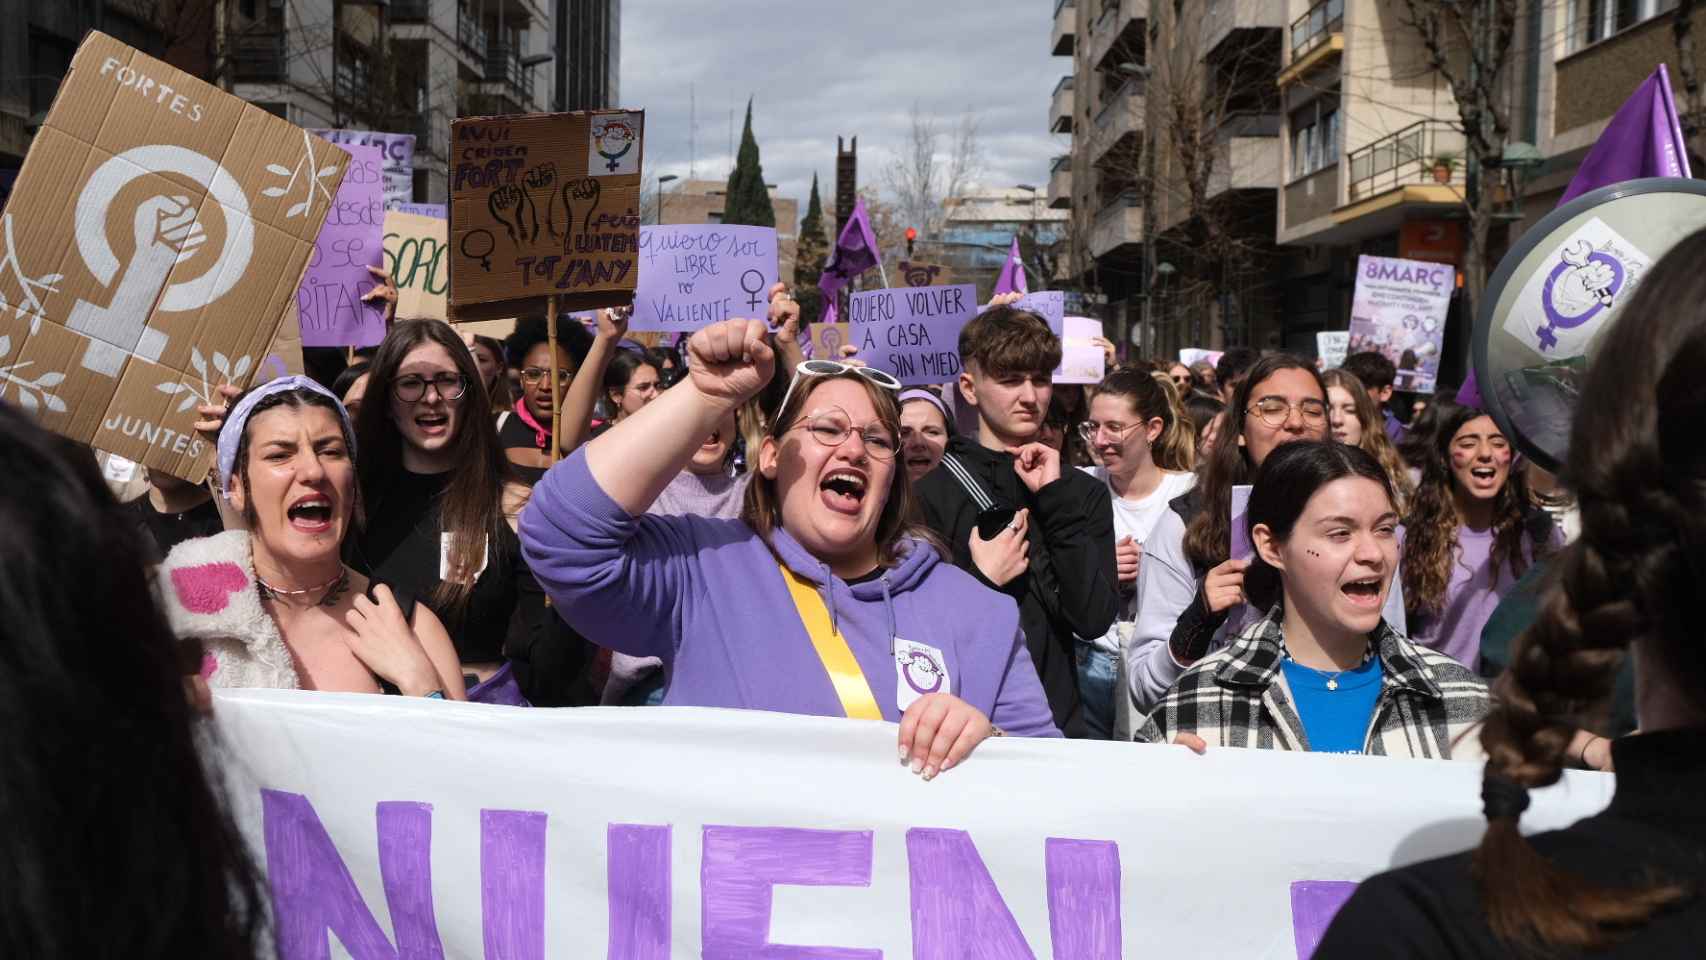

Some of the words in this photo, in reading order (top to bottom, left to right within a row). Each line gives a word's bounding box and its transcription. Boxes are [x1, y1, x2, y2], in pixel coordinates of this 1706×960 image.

[101, 57, 204, 121] FORTES
[455, 159, 524, 191] FORT
[639, 231, 728, 264] quiero
[515, 256, 561, 287] TOT
[674, 255, 720, 279] LIBRE
[1366, 262, 1444, 290] 8MARÇ
[652, 294, 731, 322] VALIENTE
[852, 294, 895, 324] QUIERO
[905, 288, 966, 316] VOLVER
[863, 328, 876, 350] A
[887, 323, 931, 346] CASA
[888, 354, 915, 378] SIN
[105, 415, 205, 458] JUNTES
